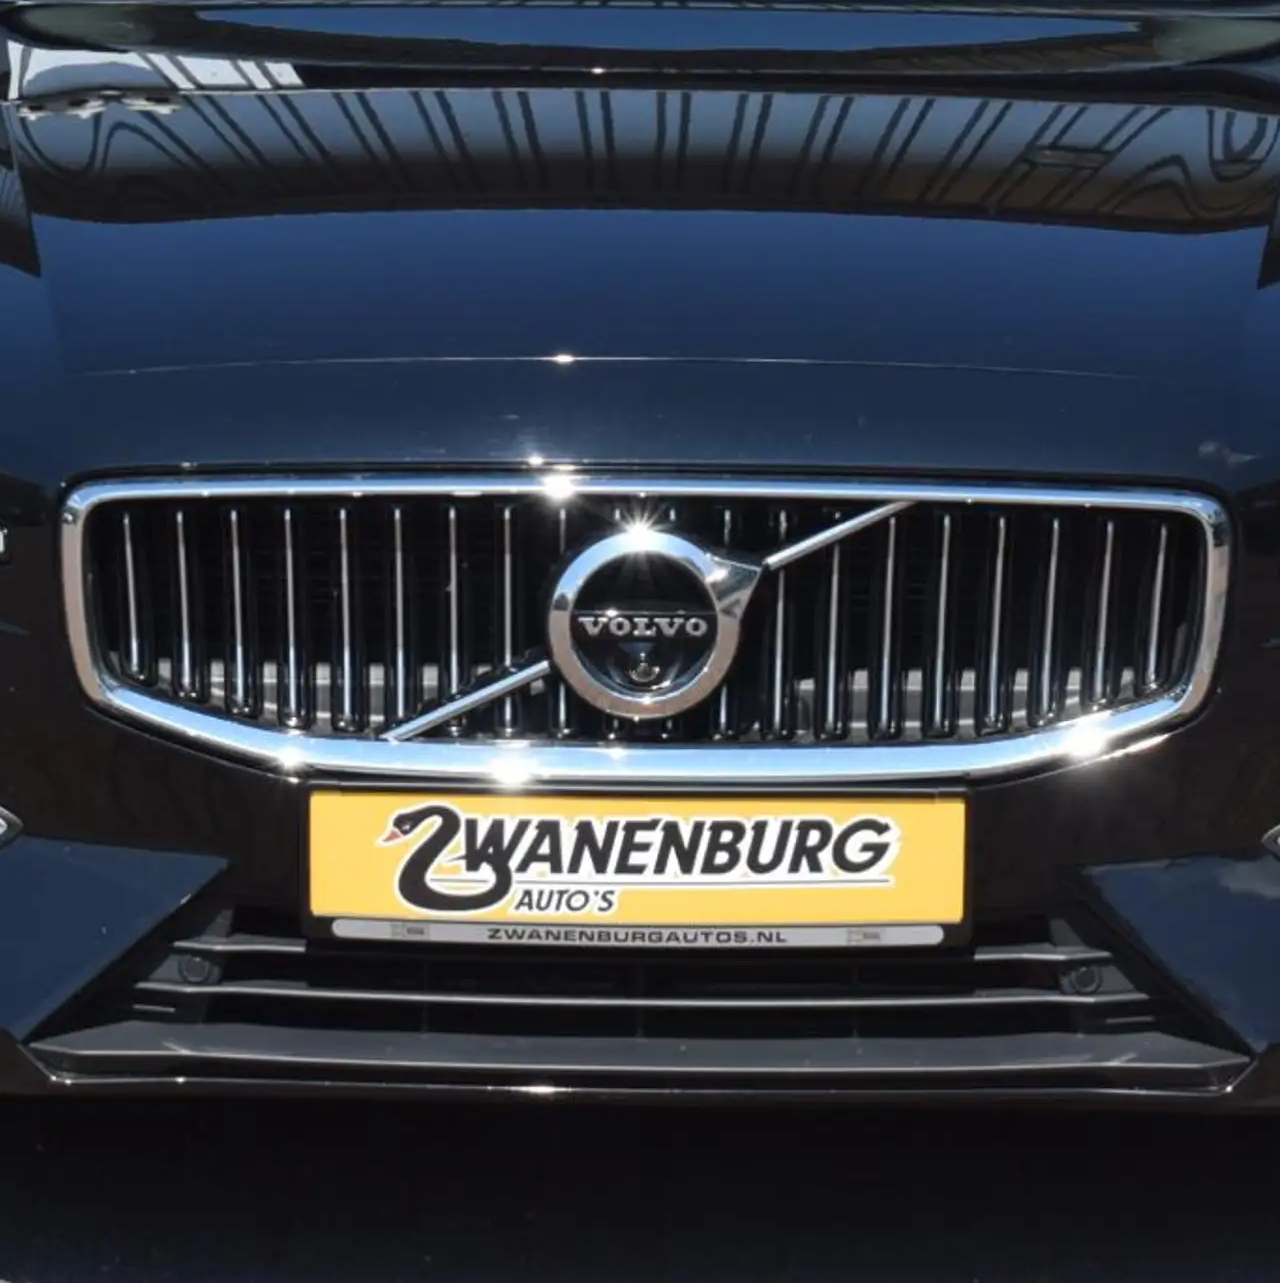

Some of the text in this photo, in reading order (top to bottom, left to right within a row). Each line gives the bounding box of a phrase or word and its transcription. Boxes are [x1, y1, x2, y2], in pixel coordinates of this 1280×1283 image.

[577, 617, 708, 637] VOLVO
[382, 804, 891, 912] ZWANENBURG
[514, 888, 615, 912] AUTO'S
[487, 927, 788, 944] ZWANENBURGAUTOS.NL
